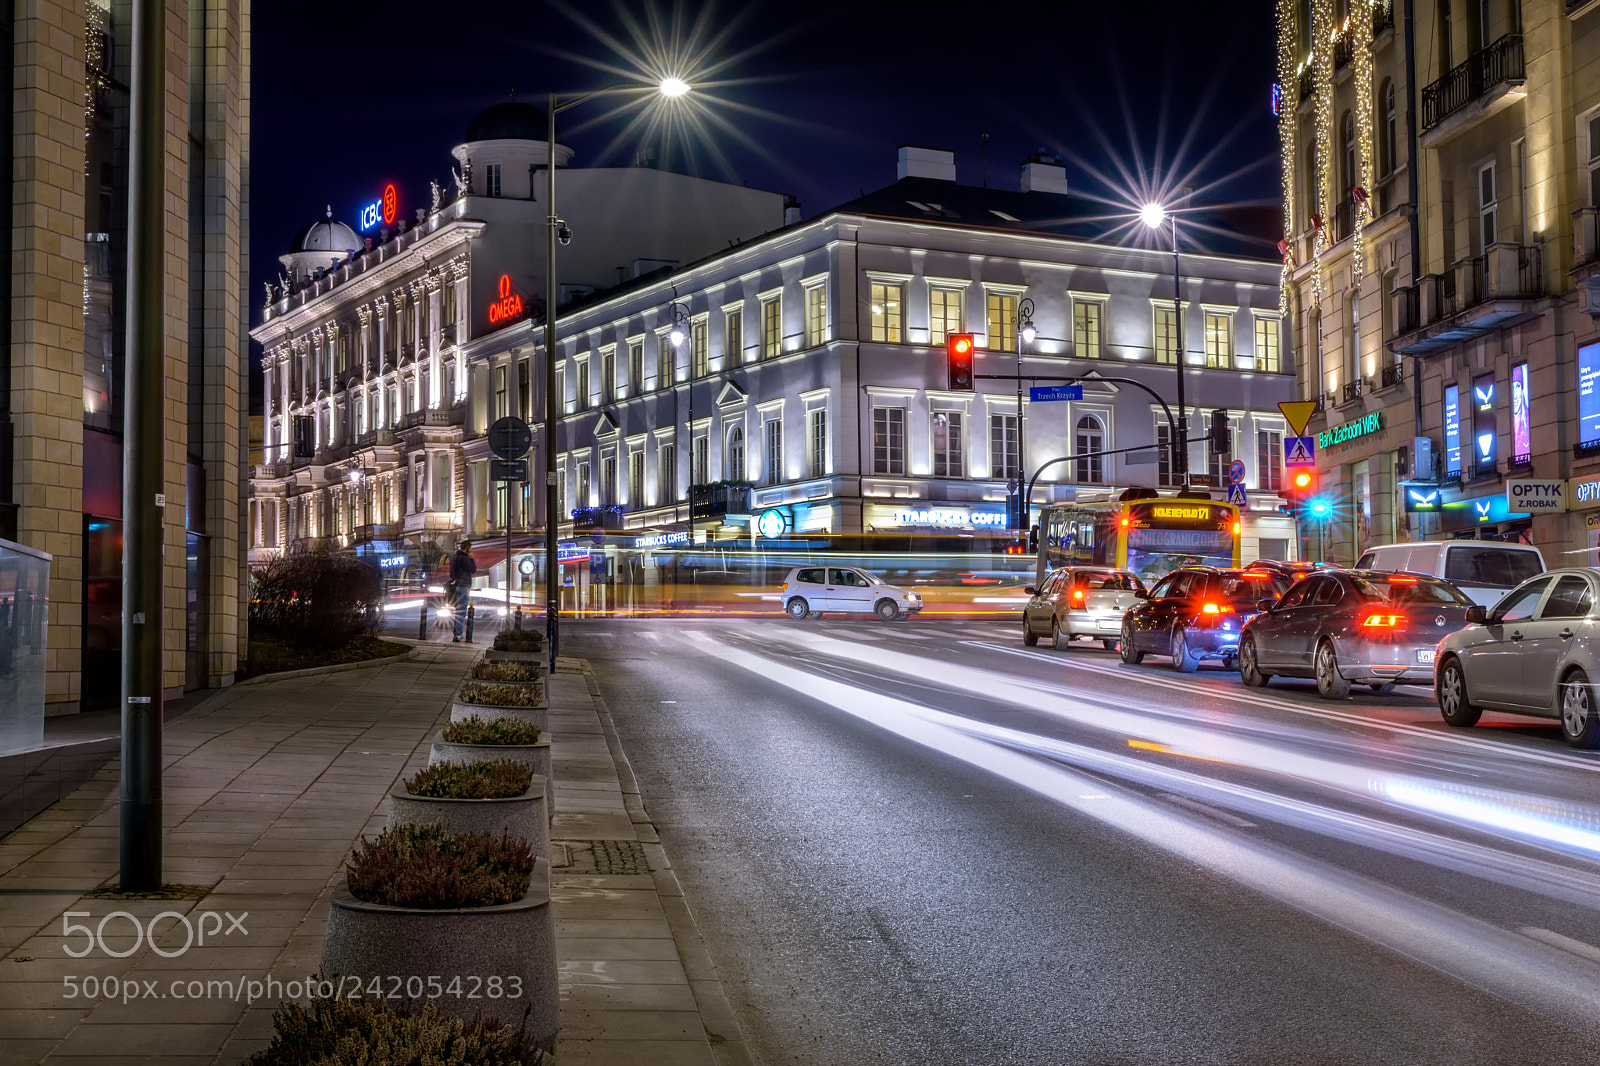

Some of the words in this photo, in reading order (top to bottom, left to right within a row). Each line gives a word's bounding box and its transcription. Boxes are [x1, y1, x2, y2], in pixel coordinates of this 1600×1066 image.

[361, 199, 382, 231] ICBC
[489, 294, 522, 323] OMEGA
[1319, 429, 1334, 449] Bank
[1334, 418, 1362, 444] Zachodni
[1362, 411, 1380, 435] WBK
[1512, 484, 1562, 497] OPTYK
[1518, 500, 1558, 508] Z.ROBAK
[895, 510, 969, 524] STARBUCKS
[635, 535, 667, 548] STARBUCKS
[667, 531, 688, 543] COFFEE
